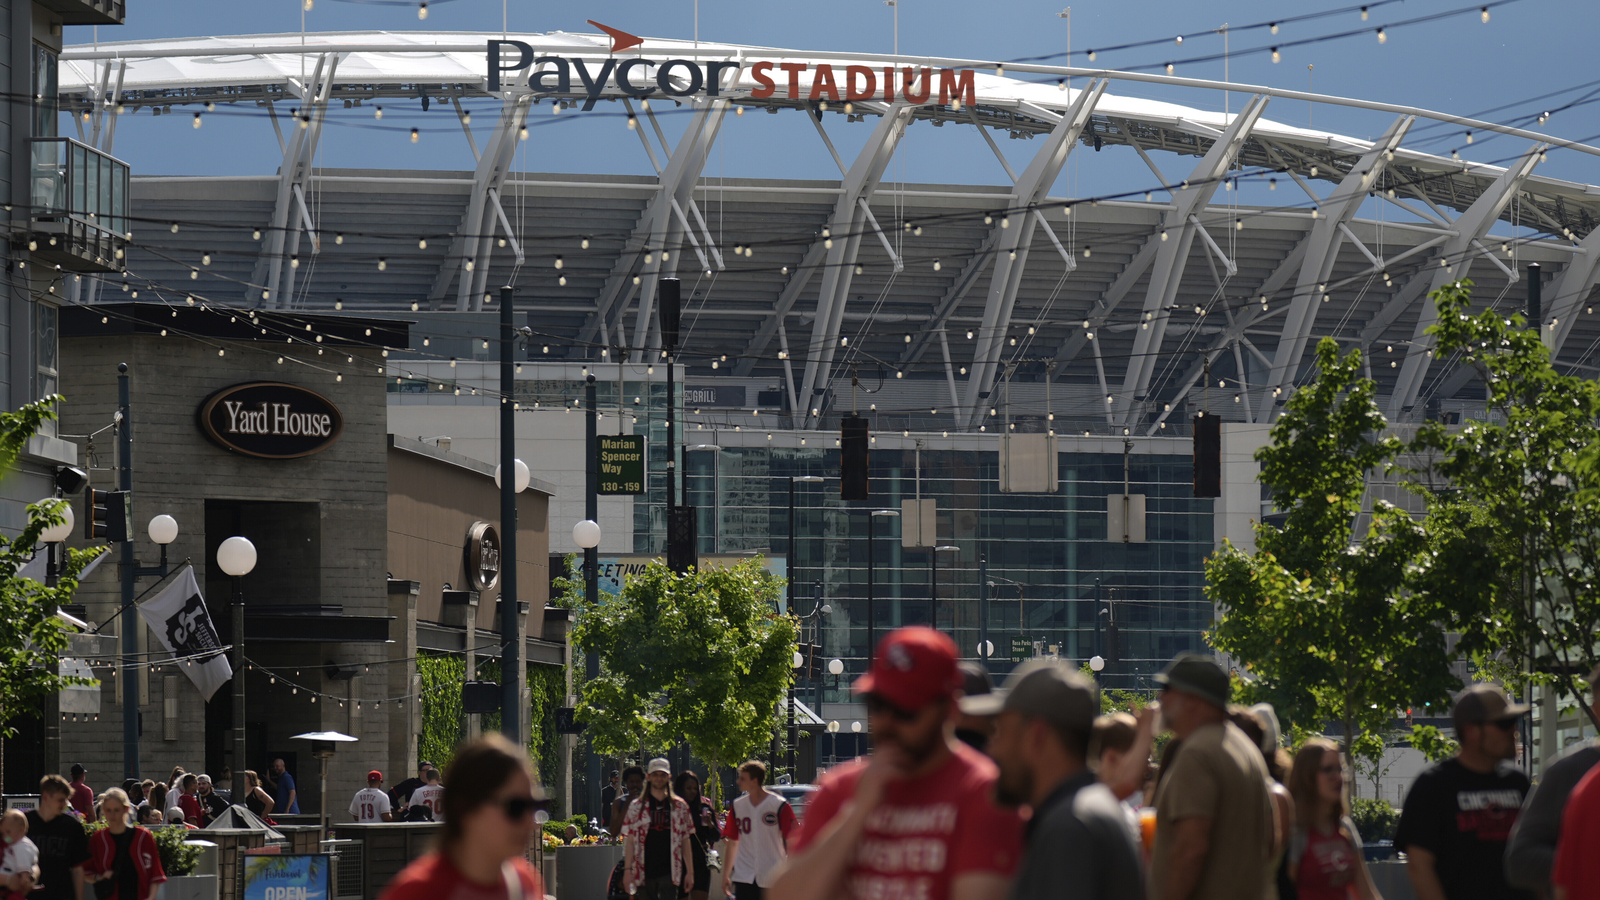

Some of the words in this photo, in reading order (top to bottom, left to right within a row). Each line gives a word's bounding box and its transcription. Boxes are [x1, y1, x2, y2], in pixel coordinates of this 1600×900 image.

[487, 39, 740, 111] Paycor
[751, 61, 976, 106] STADIUM
[693, 390, 716, 403] GRILL
[224, 401, 268, 434] Yard
[272, 403, 332, 437] House
[601, 439, 636, 449] Marian
[601, 451, 640, 463] Spencer
[601, 463, 622, 475] Way
[601, 482, 618, 491] 130
[624, 482, 640, 491] 159
[578, 563, 648, 578] EETING
[422, 789, 442, 798] GRIFFE
[360, 802, 375, 820] 19
[264, 868, 301, 880] Fishbowl
[265, 886, 307, 900] OPEN
